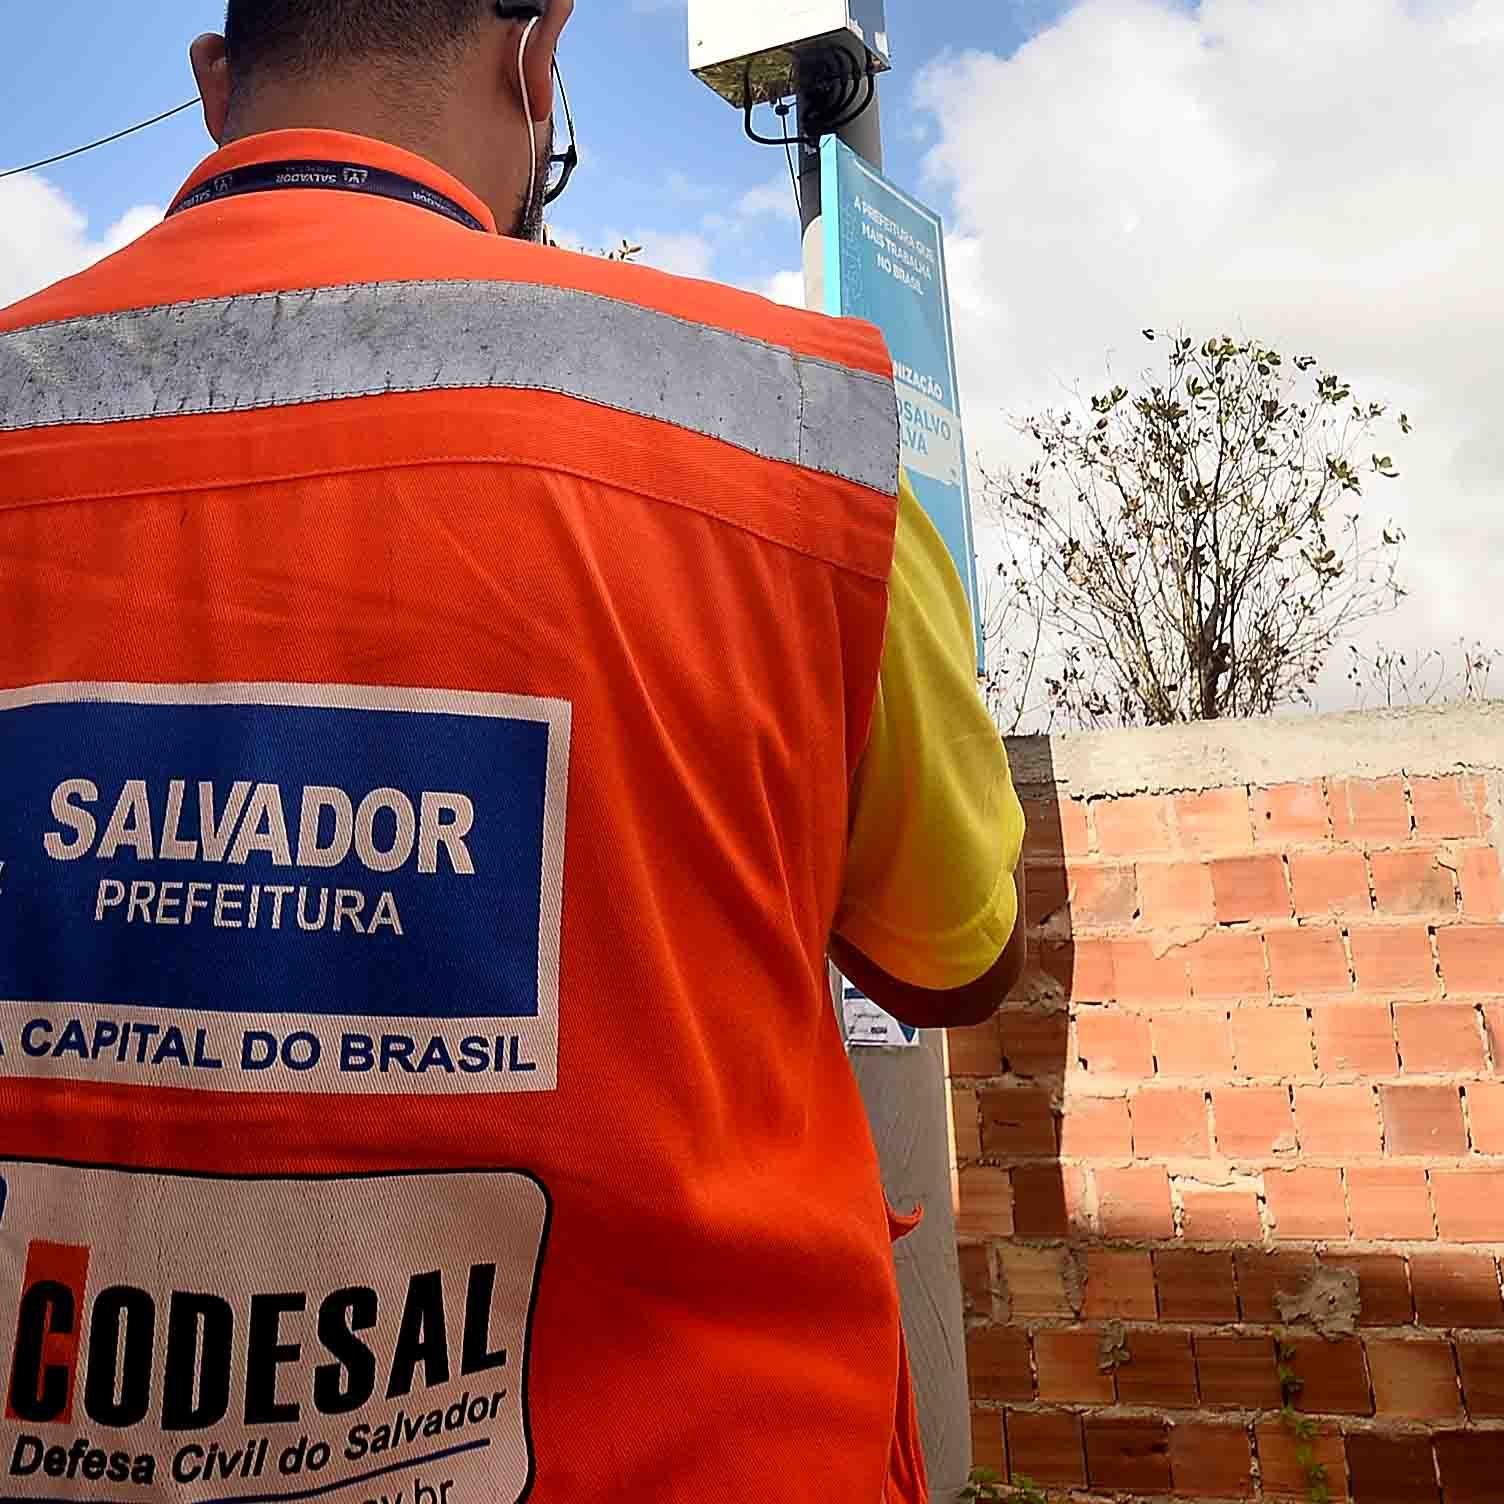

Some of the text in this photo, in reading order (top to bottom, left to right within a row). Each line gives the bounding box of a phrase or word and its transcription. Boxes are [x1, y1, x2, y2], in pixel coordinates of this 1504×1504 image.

[275, 172, 338, 184] SALVADOR
[861, 221, 933, 281] MAIS TRABALHA
[863, 202, 914, 251] PREFEITURA
[877, 252, 925, 296] NO BRASIL
[43, 778, 476, 876] SALVADOR
[94, 879, 403, 936] PREFEITURA
[20, 1018, 224, 1072] CAPITAL
[241, 1030, 322, 1073] DO
[338, 1034, 537, 1073] BRASIL
[9, 1263, 507, 1432] CODESAL
[9, 1383, 507, 1485] Defesa Civil do Salvador
